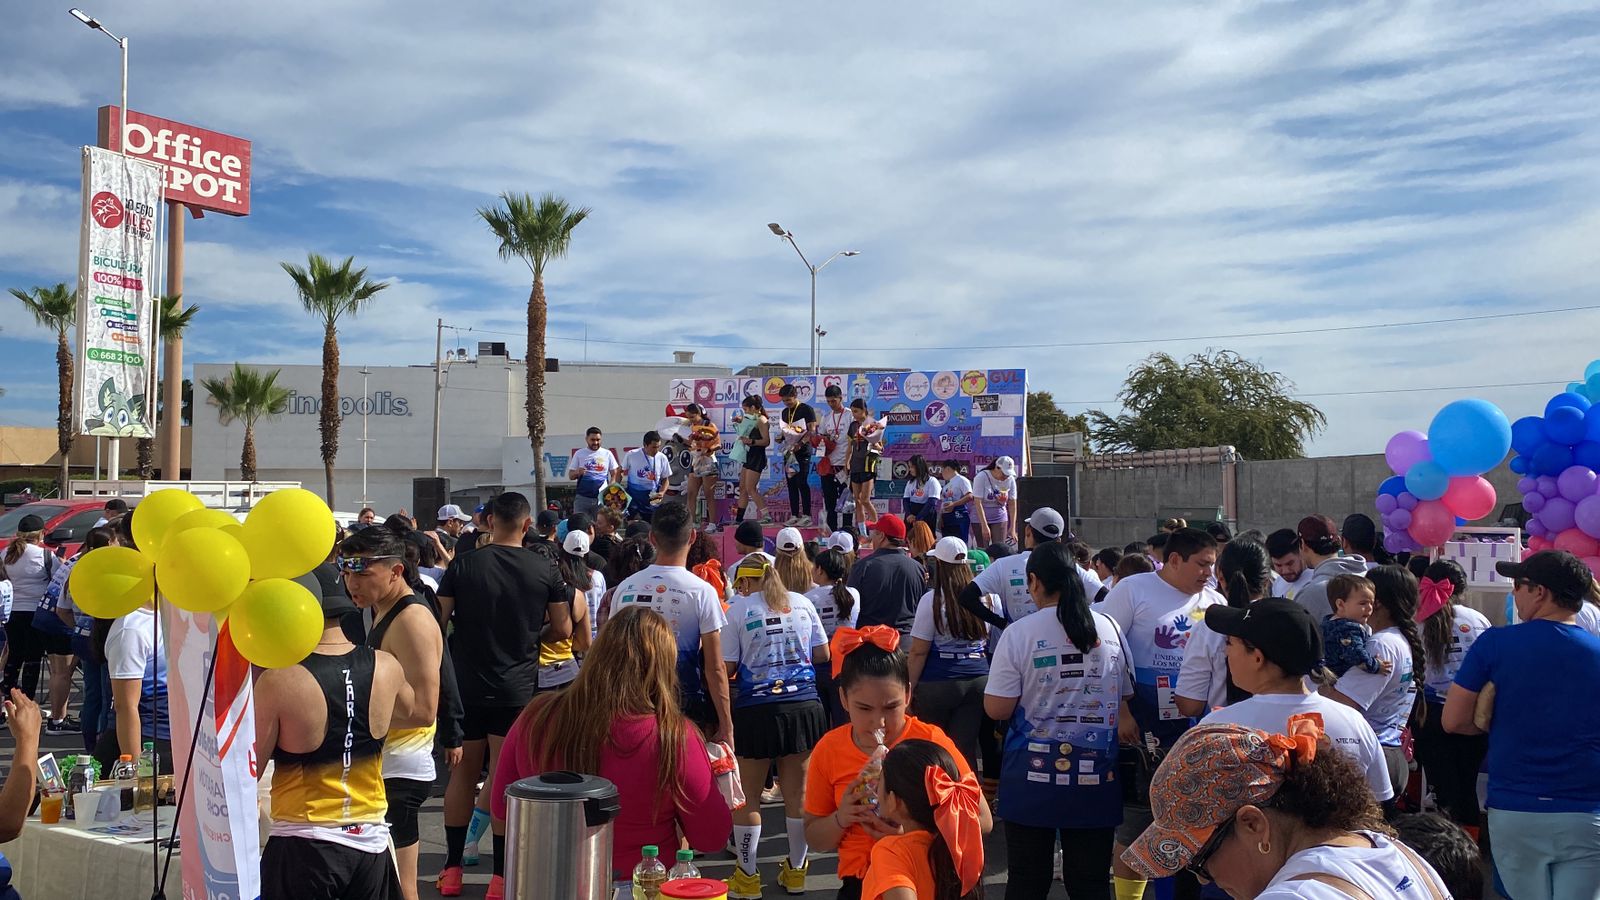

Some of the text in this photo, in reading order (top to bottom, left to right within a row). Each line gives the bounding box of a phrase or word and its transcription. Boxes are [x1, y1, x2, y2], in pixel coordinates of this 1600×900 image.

[124, 123, 242, 177] Office
[97, 274, 122, 286] 100%
[100, 351, 116, 360] 668
[270, 390, 408, 420] inpolis
[741, 833, 752, 863] adidas
